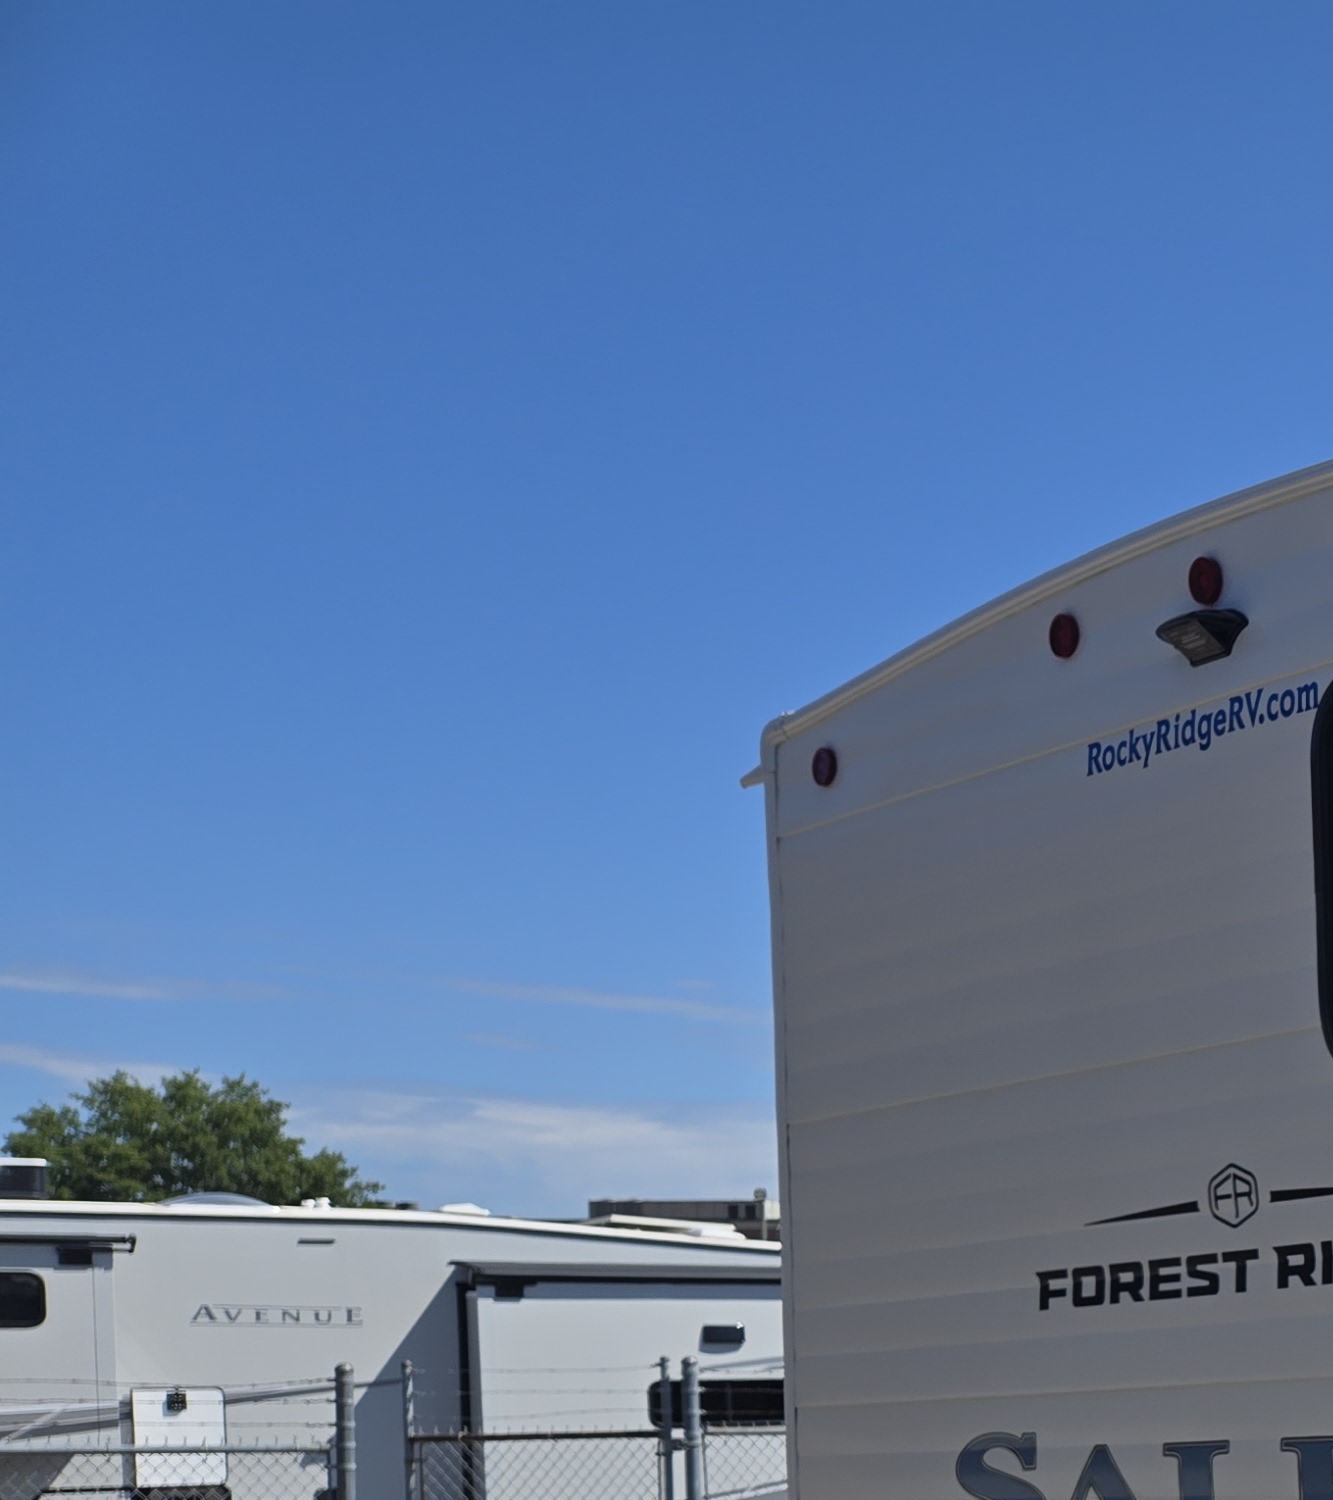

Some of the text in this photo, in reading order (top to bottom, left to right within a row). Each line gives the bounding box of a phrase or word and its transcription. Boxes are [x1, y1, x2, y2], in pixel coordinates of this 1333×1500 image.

[1086, 681, 1320, 777] RockyRidgeRV.com
[1036, 1248, 1260, 1312] FOREST
[189, 1303, 363, 1326] AVENUE
